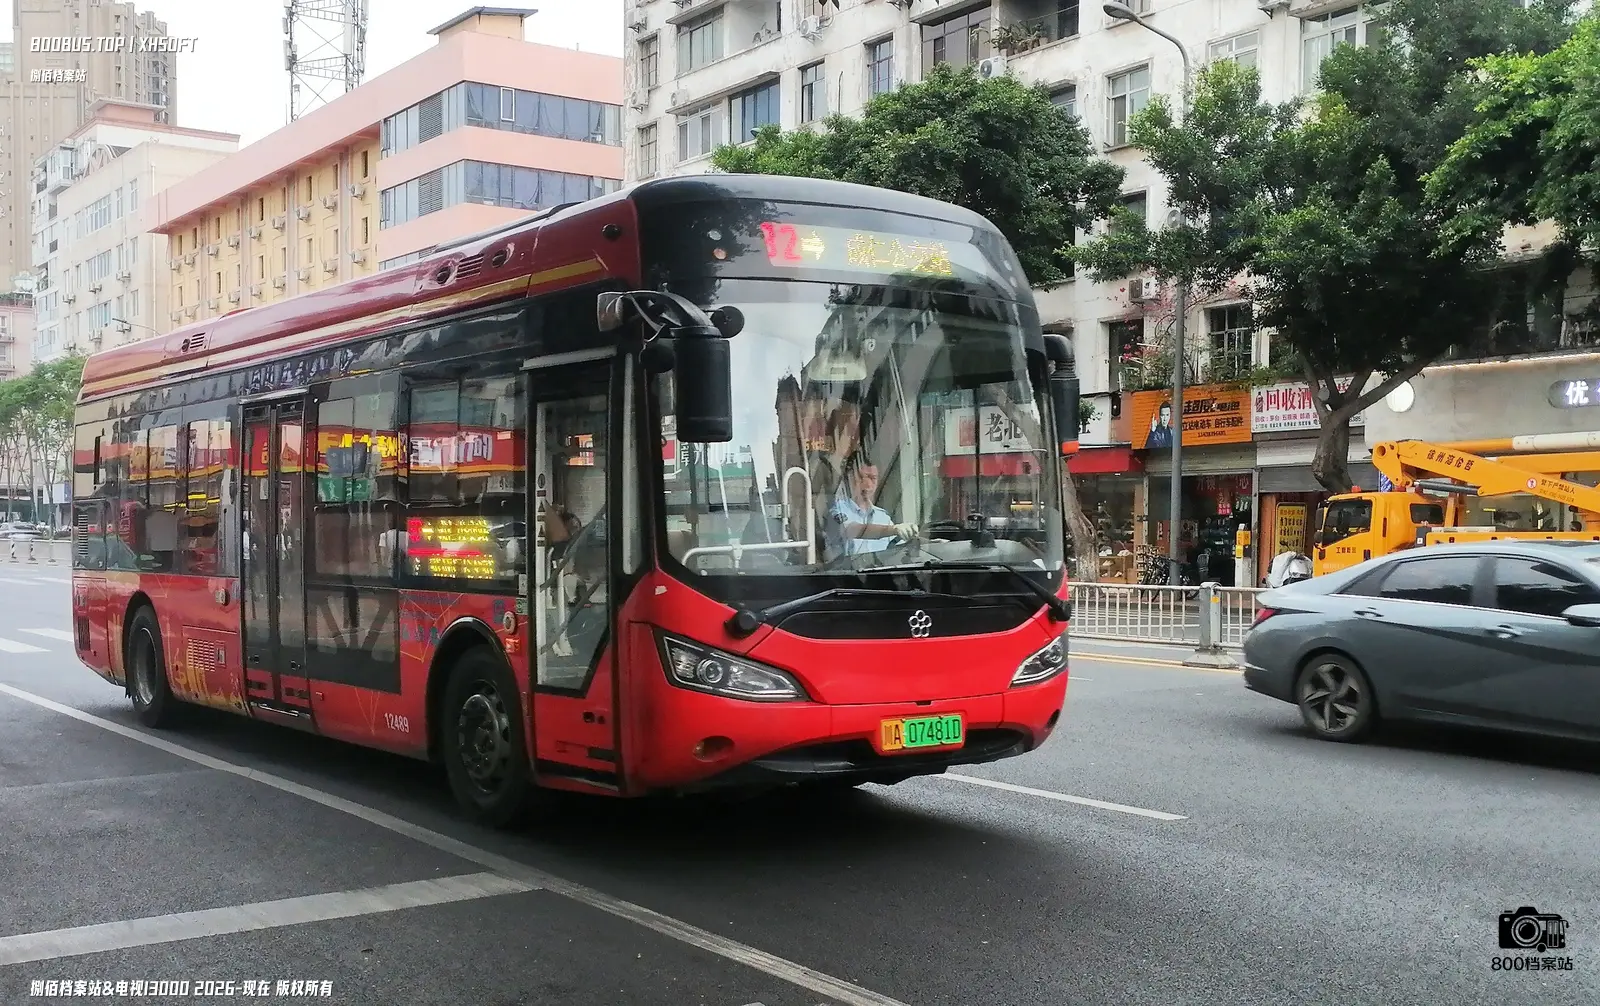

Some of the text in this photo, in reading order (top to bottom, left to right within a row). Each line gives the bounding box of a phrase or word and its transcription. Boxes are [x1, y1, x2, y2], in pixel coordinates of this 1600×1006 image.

[1565, 380, 1600, 405] 优
[384, 712, 409, 734] 12489
[908, 719, 961, 743] 07481D
